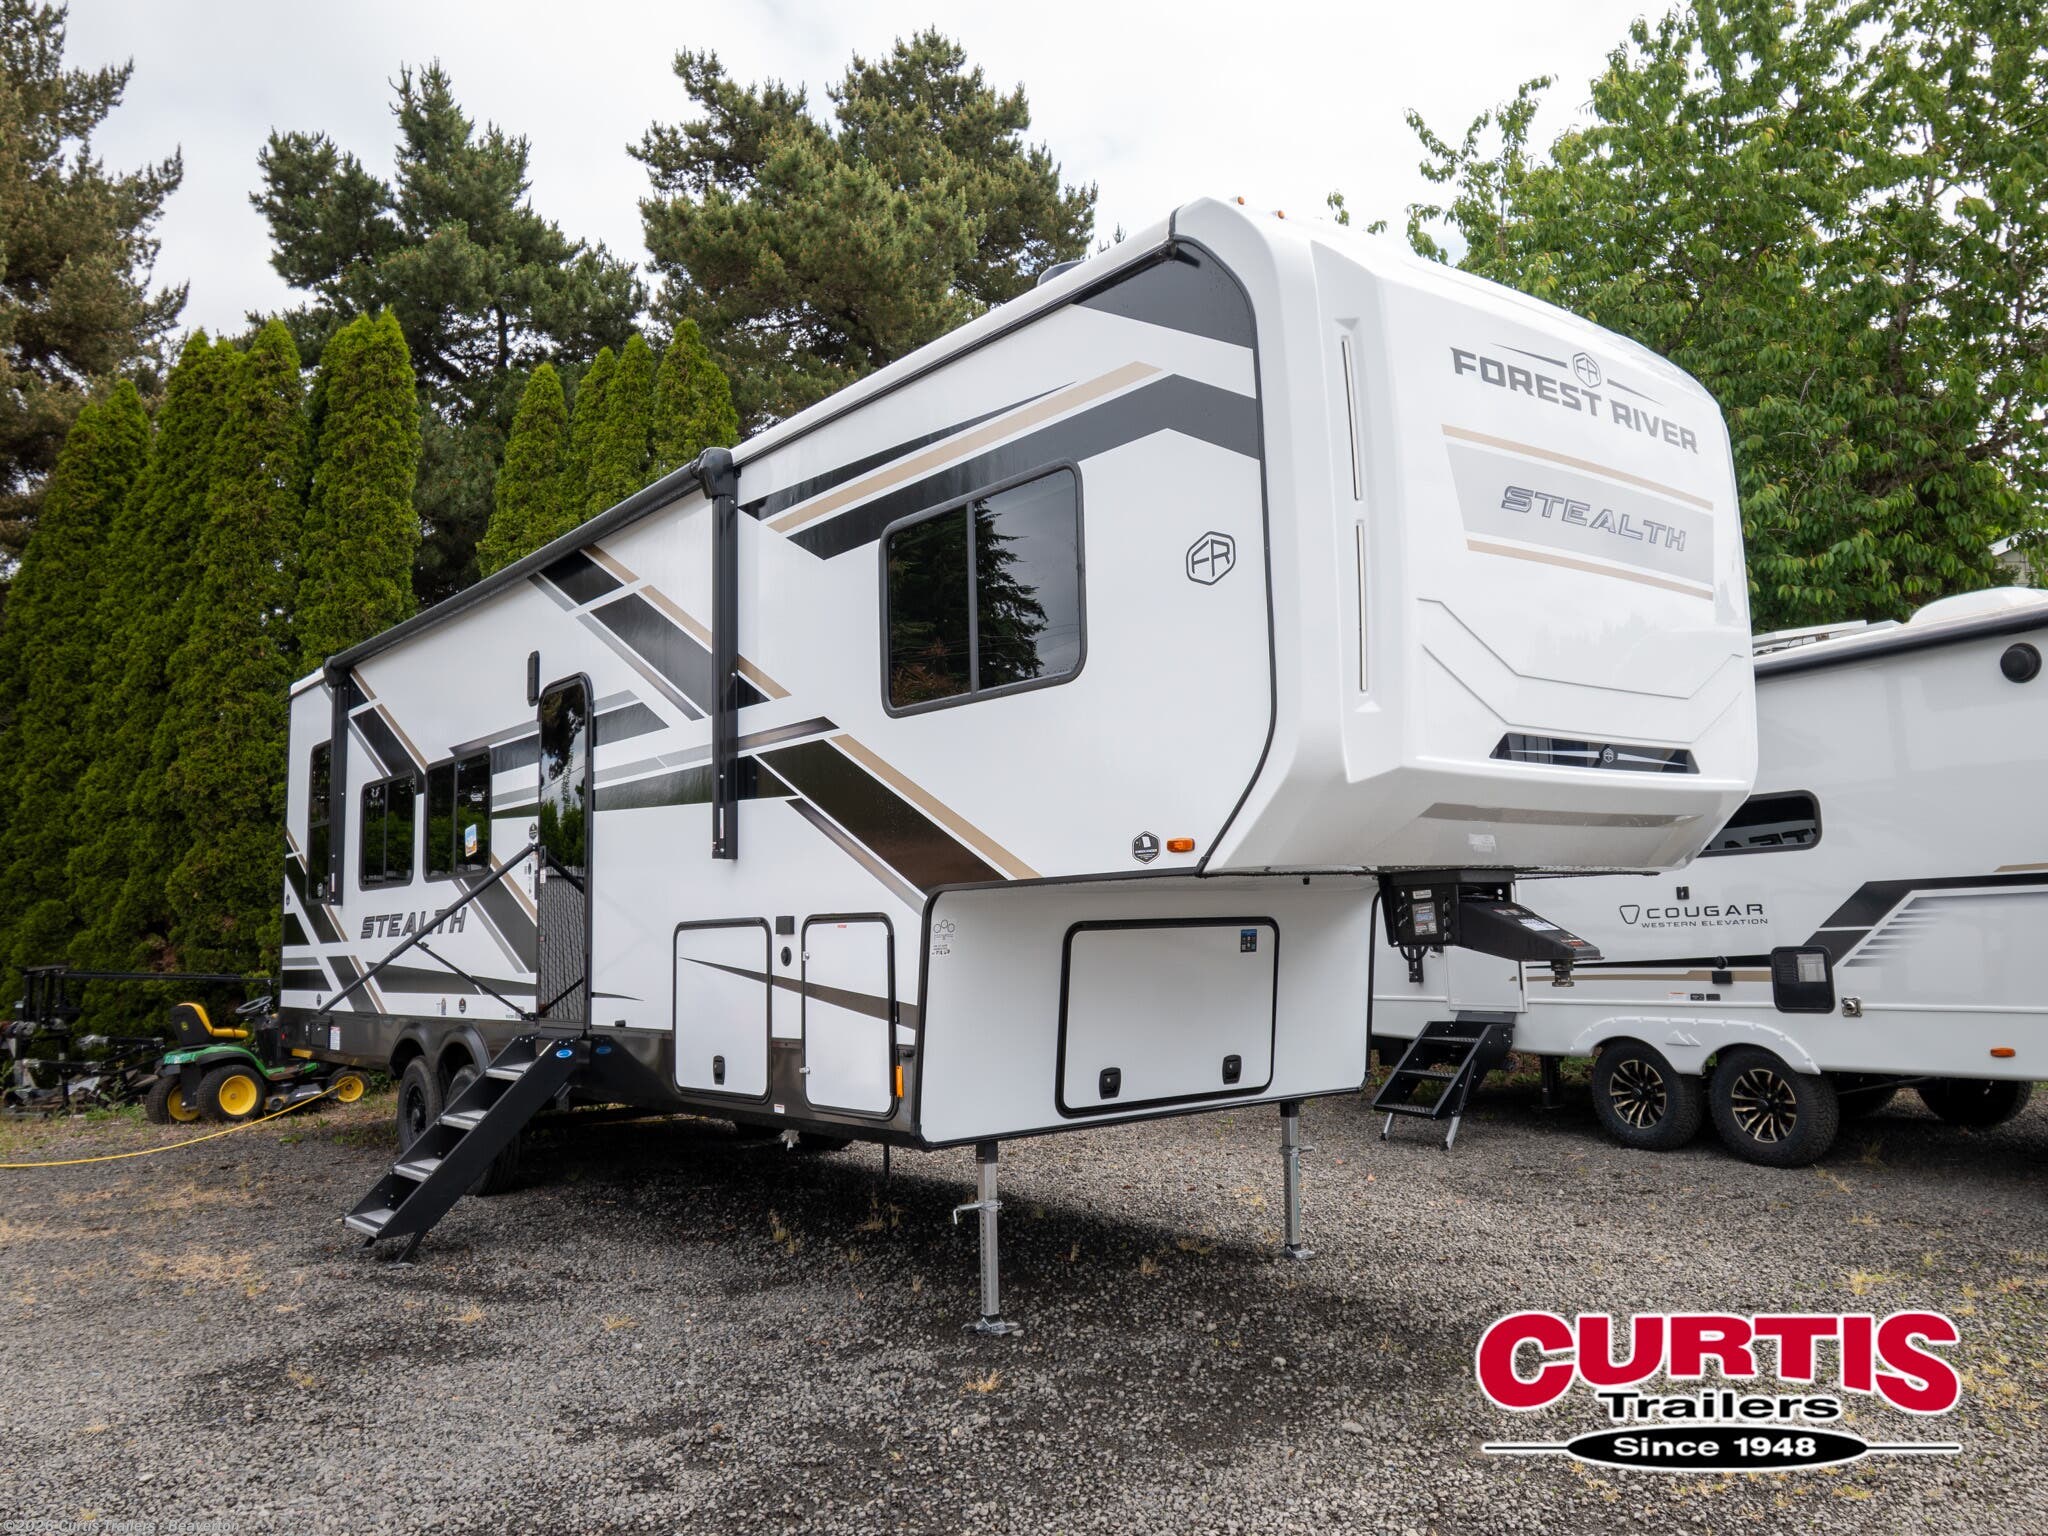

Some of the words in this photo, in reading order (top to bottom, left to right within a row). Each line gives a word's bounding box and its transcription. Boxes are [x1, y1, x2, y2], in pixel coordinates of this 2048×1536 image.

[1449, 347, 1602, 416] FOREST
[1609, 399, 1698, 454] RIVER
[1501, 485, 1687, 552] STEALTH
[1641, 921, 1697, 929] WESTERN
[1701, 918, 1768, 927] ELEVATION
[1646, 904, 1764, 918] COUGAR
